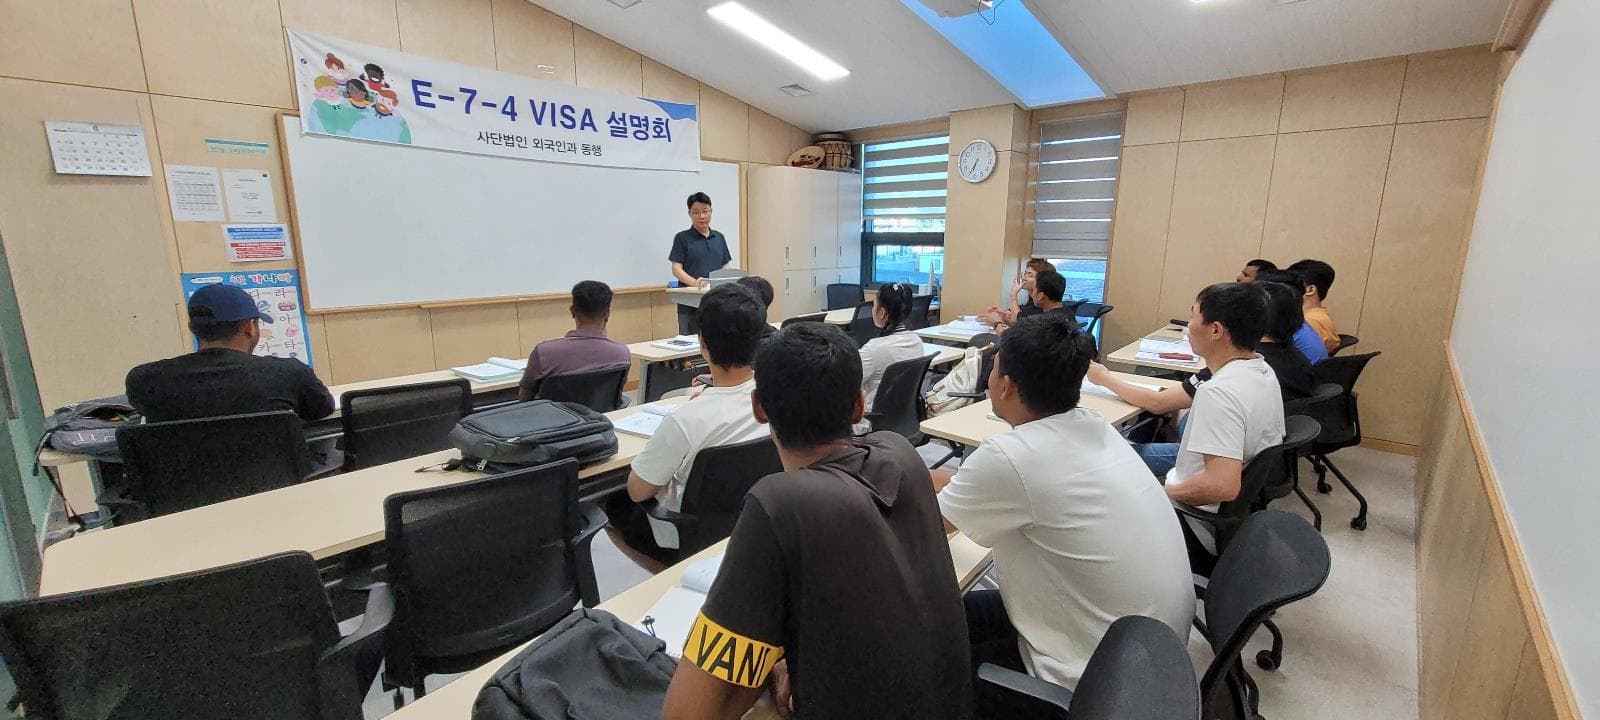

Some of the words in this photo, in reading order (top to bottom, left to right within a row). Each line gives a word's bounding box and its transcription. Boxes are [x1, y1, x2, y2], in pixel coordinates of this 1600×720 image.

[411, 79, 518, 122] E-7-4
[529, 98, 598, 133] VISA
[606, 112, 673, 142] 설명회
[476, 131, 529, 150] 사단법인
[532, 138, 578, 155] 외국인과
[580, 142, 603, 157] 동행
[279, 314, 293, 324] 아
